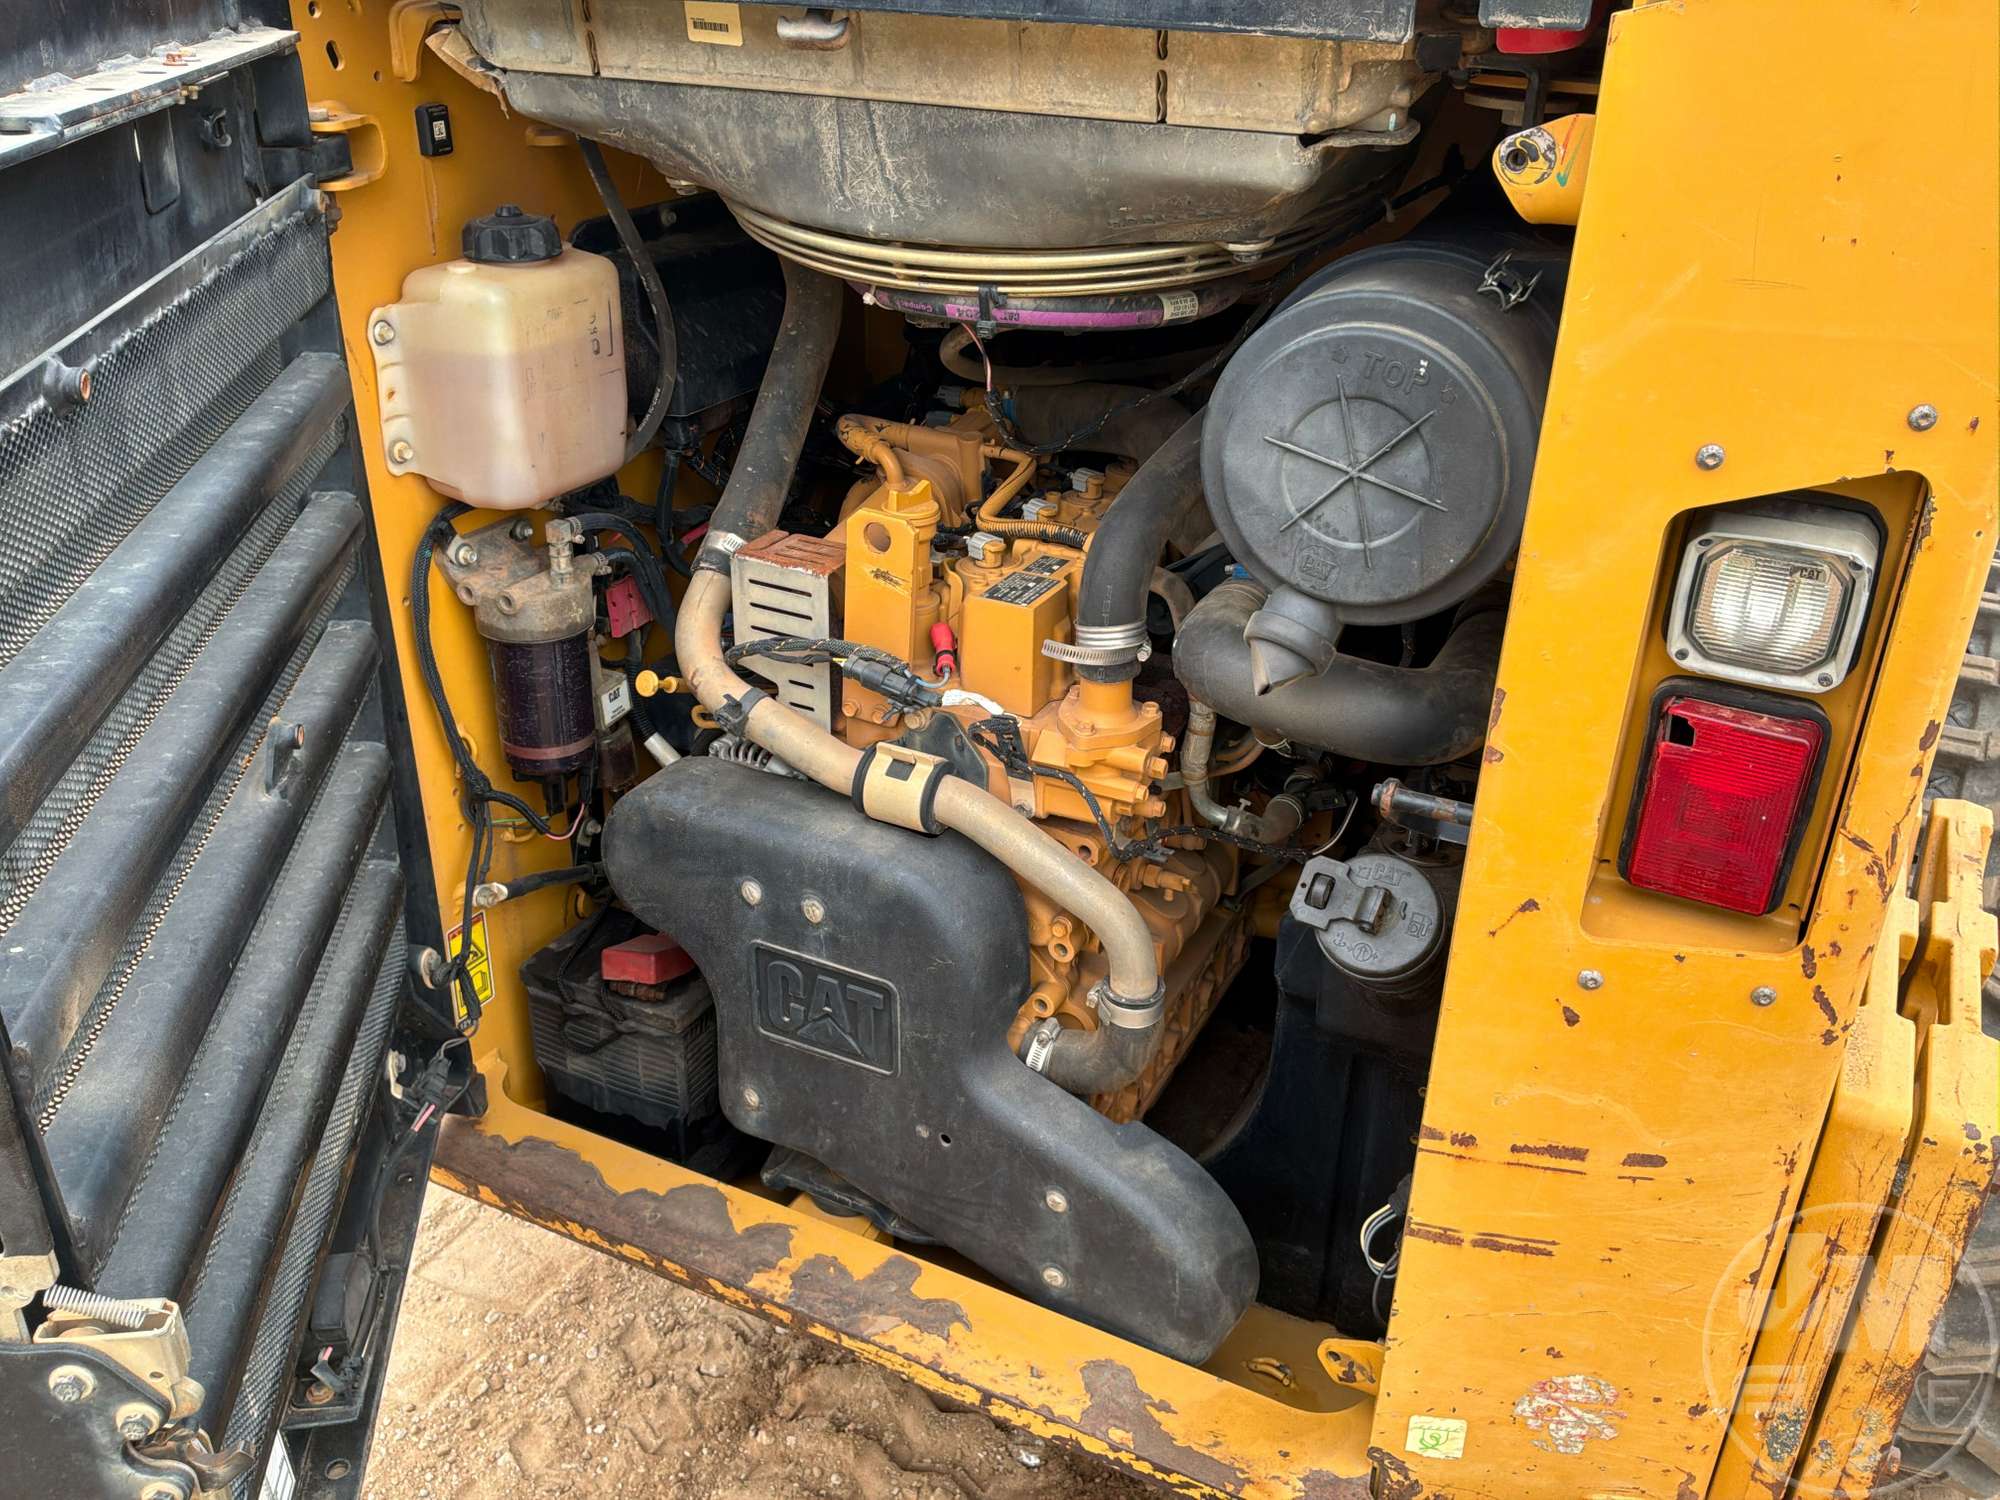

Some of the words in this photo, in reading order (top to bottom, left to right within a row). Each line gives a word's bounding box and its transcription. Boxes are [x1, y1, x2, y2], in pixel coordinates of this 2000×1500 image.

[1363, 350, 1431, 395] TOP
[1799, 567, 1823, 581] CAT
[609, 686, 622, 704] CAT
[1372, 862, 1411, 887] CAT
[767, 959, 884, 1064] CAT
